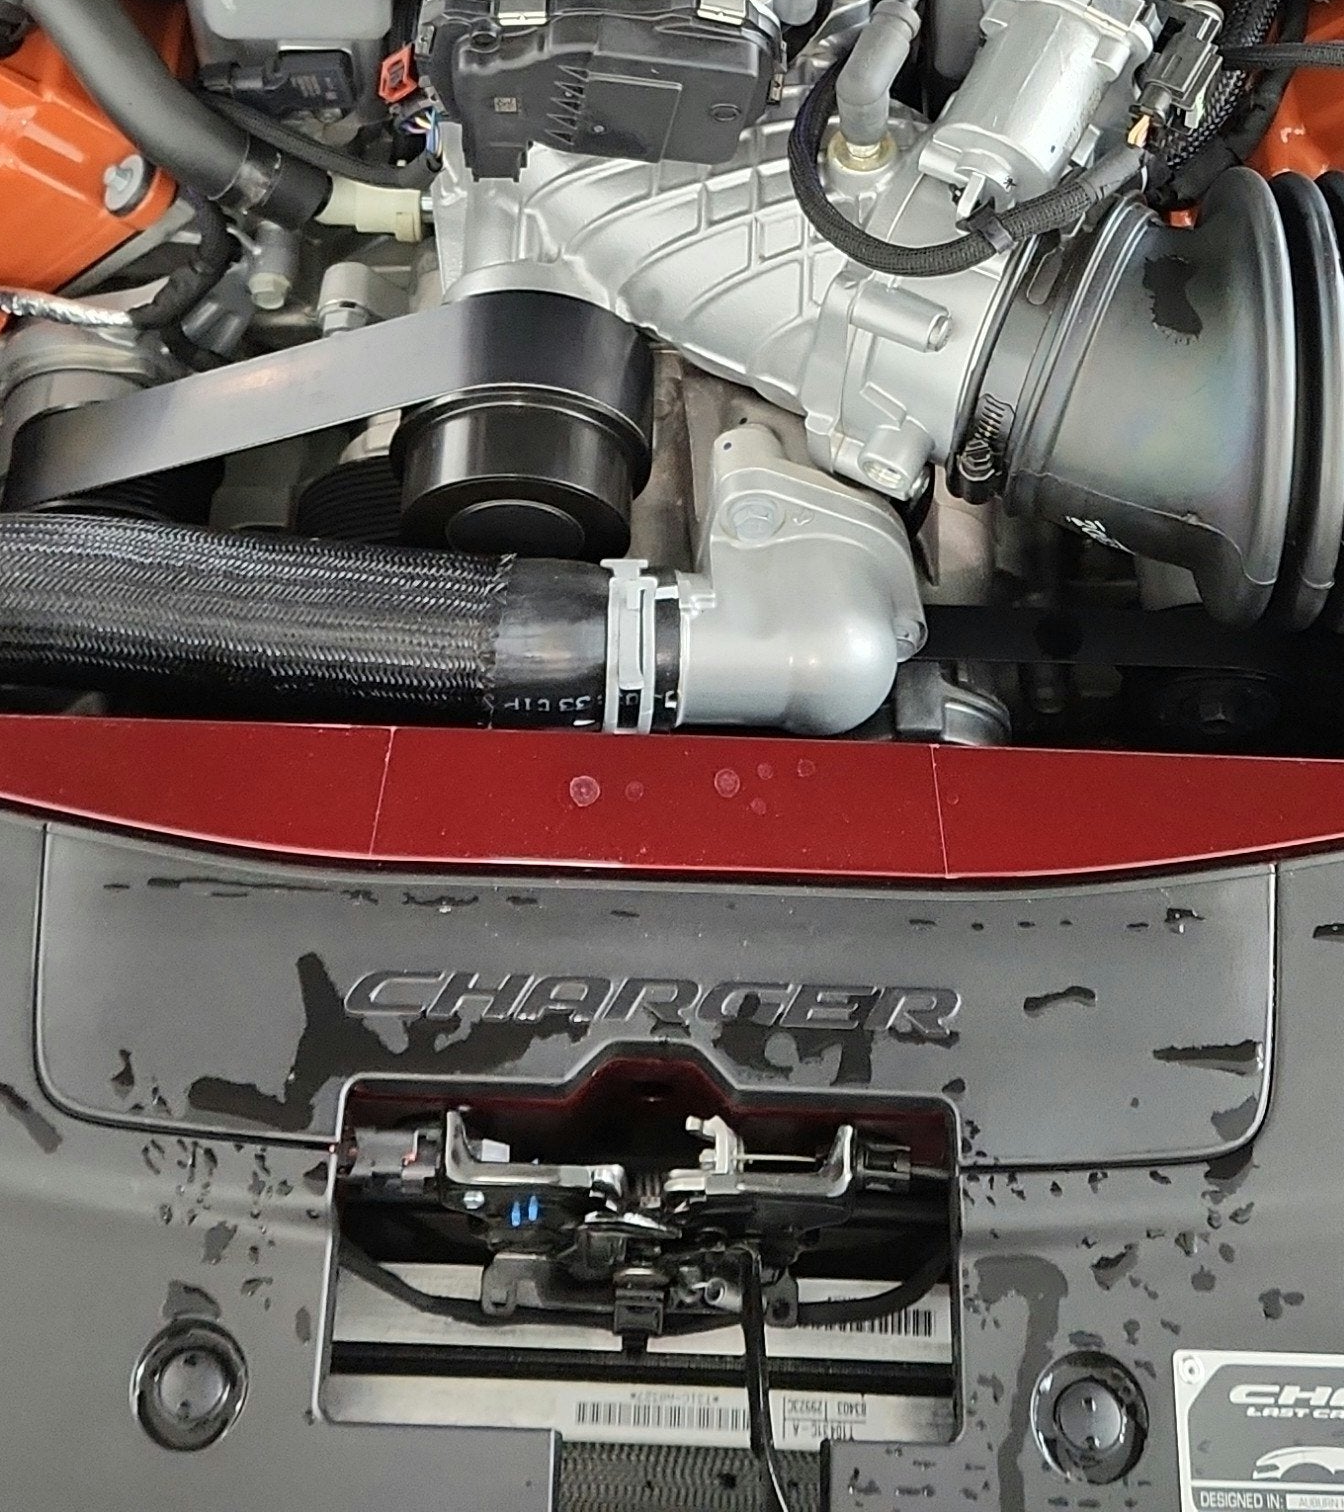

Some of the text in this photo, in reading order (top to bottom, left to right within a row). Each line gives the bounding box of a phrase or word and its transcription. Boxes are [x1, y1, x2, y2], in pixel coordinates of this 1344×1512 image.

[343, 970, 961, 1037] CHARGER
[1246, 1407, 1312, 1420] LAST
[1199, 1490, 1264, 1509] DESIGNED
[1267, 1493, 1285, 1510] IN:
